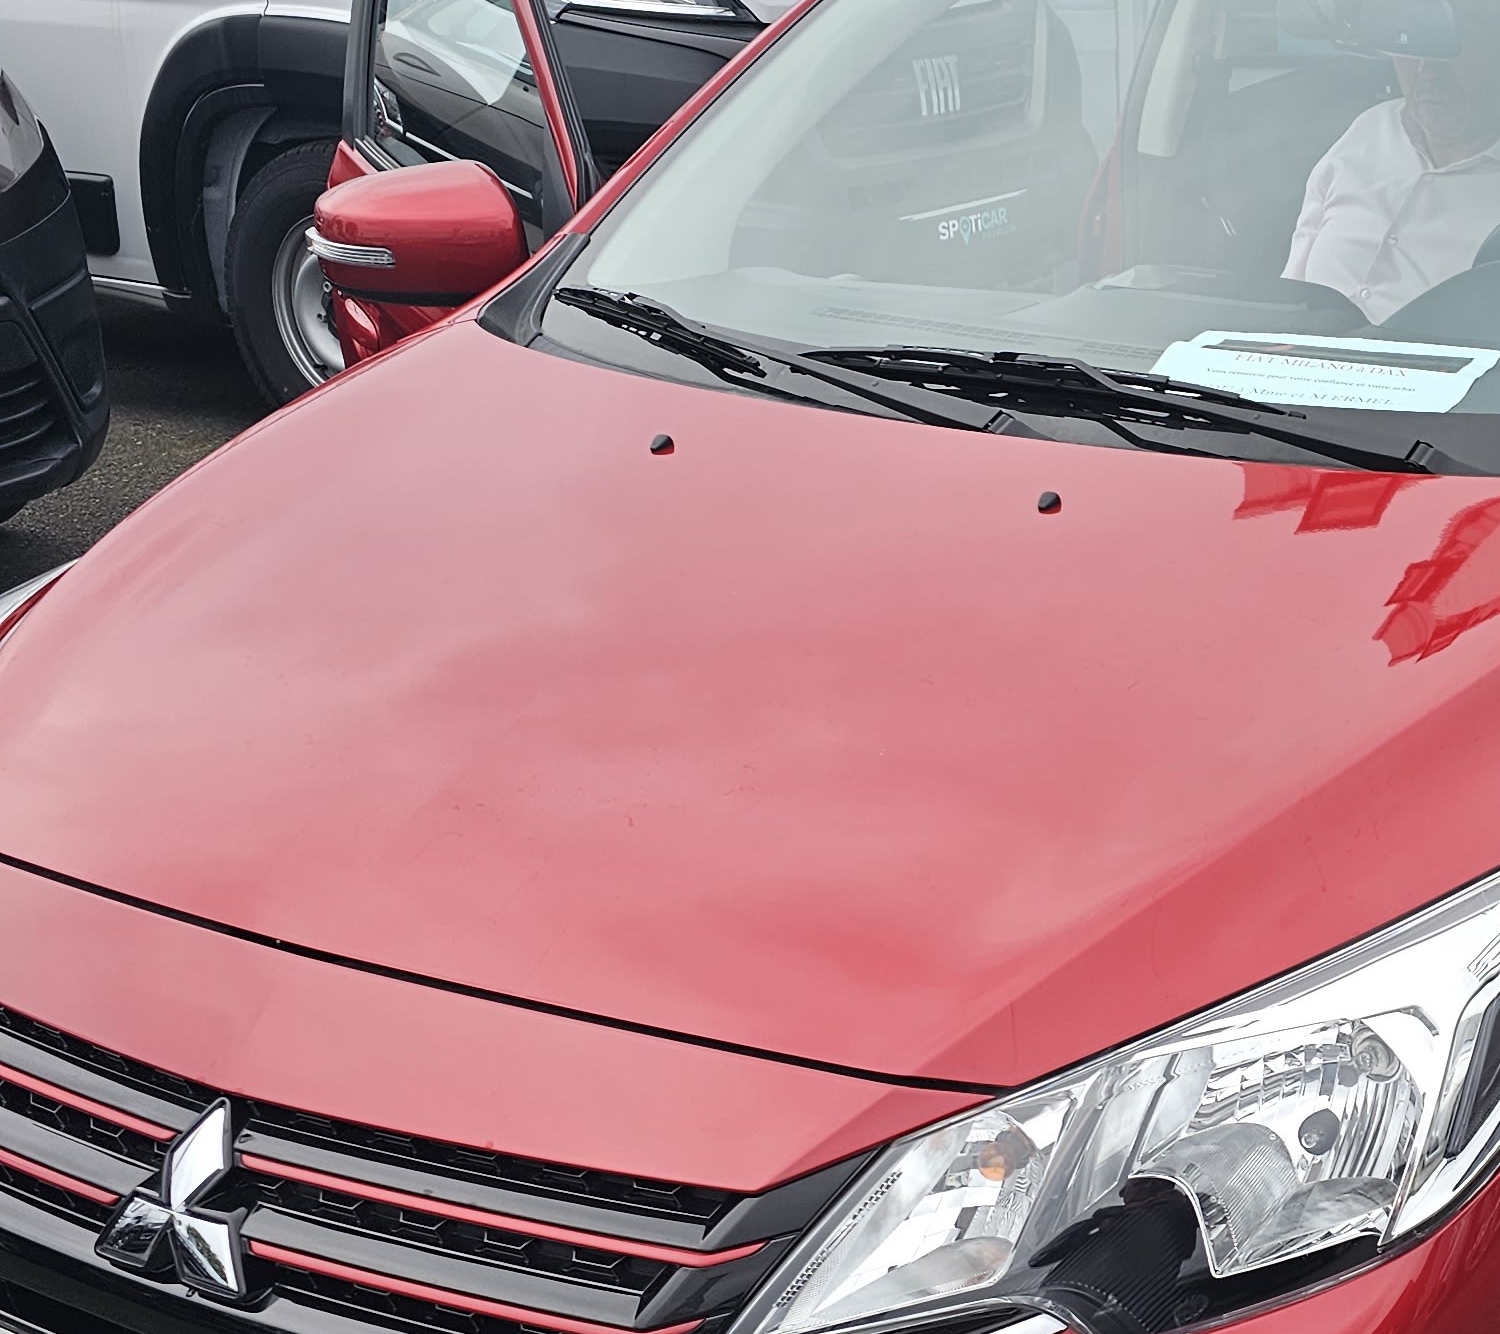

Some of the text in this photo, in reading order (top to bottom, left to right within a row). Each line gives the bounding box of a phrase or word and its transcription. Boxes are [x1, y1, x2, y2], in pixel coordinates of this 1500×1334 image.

[912, 55, 961, 116] FIAT
[1235, 354, 1277, 364] FIAT
[1281, 358, 1353, 371] MILANO
[1370, 367, 1409, 377] DAX
